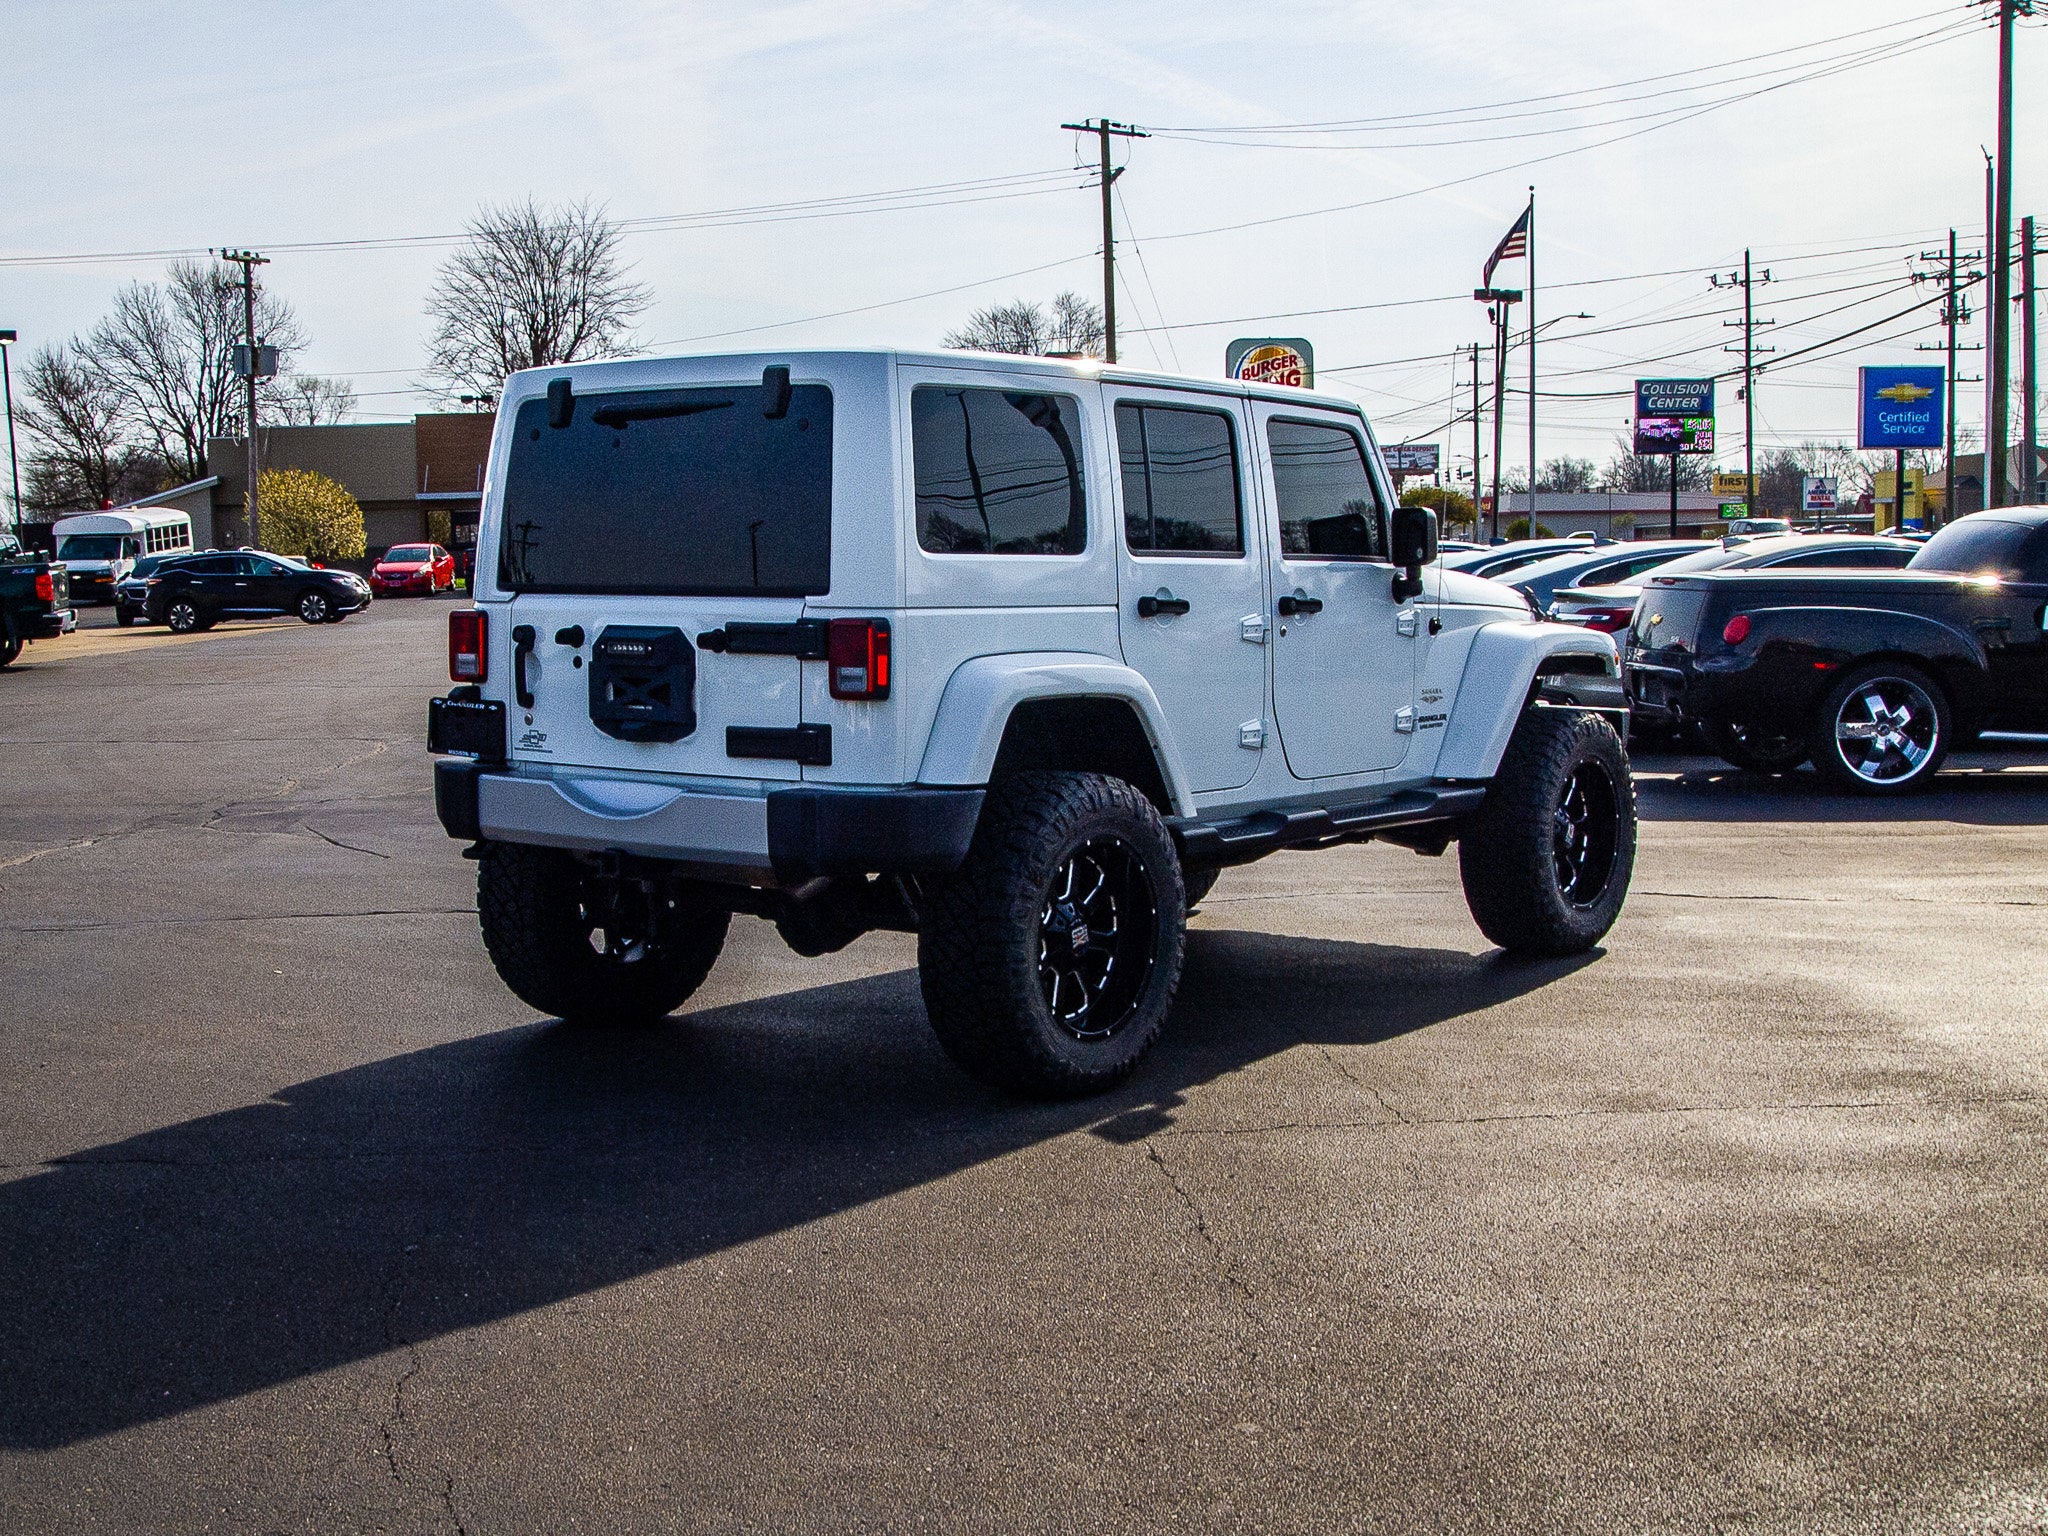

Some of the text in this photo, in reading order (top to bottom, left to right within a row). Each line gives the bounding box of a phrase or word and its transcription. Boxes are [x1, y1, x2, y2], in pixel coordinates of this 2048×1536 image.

[1242, 355, 1298, 381] BURGER
[1879, 411, 1930, 422] Certified
[1882, 423, 1926, 434] Service
